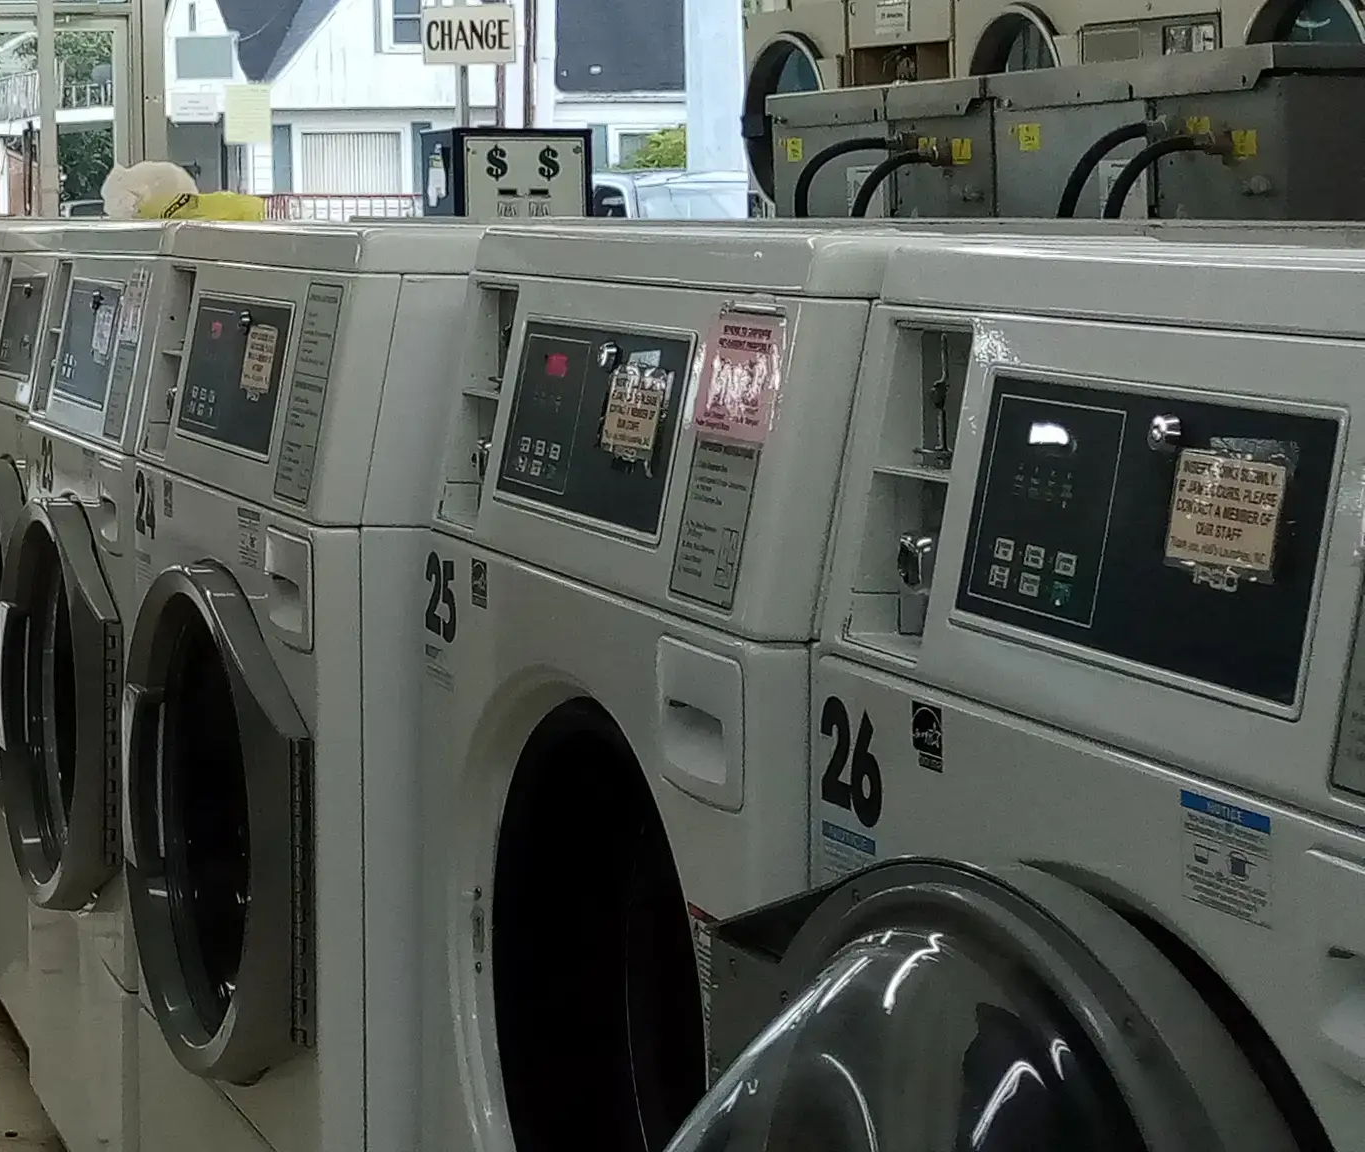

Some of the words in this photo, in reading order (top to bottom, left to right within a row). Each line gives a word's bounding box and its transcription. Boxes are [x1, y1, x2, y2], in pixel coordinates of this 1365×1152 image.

[426, 18, 511, 51] CHANGE
[486, 144, 508, 182] $
[538, 144, 560, 182] $
[135, 469, 156, 540] 24
[1176, 498, 1213, 516] CONTACT
[1214, 505, 1222, 517] A
[1222, 507, 1259, 525] MEMBER
[1259, 513, 1275, 528] OF
[1243, 489, 1278, 508] PLEASE
[1195, 521, 1215, 537] OUR
[1215, 525, 1243, 542] STAFF
[425, 551, 457, 644] 25
[821, 695, 883, 829] 26
